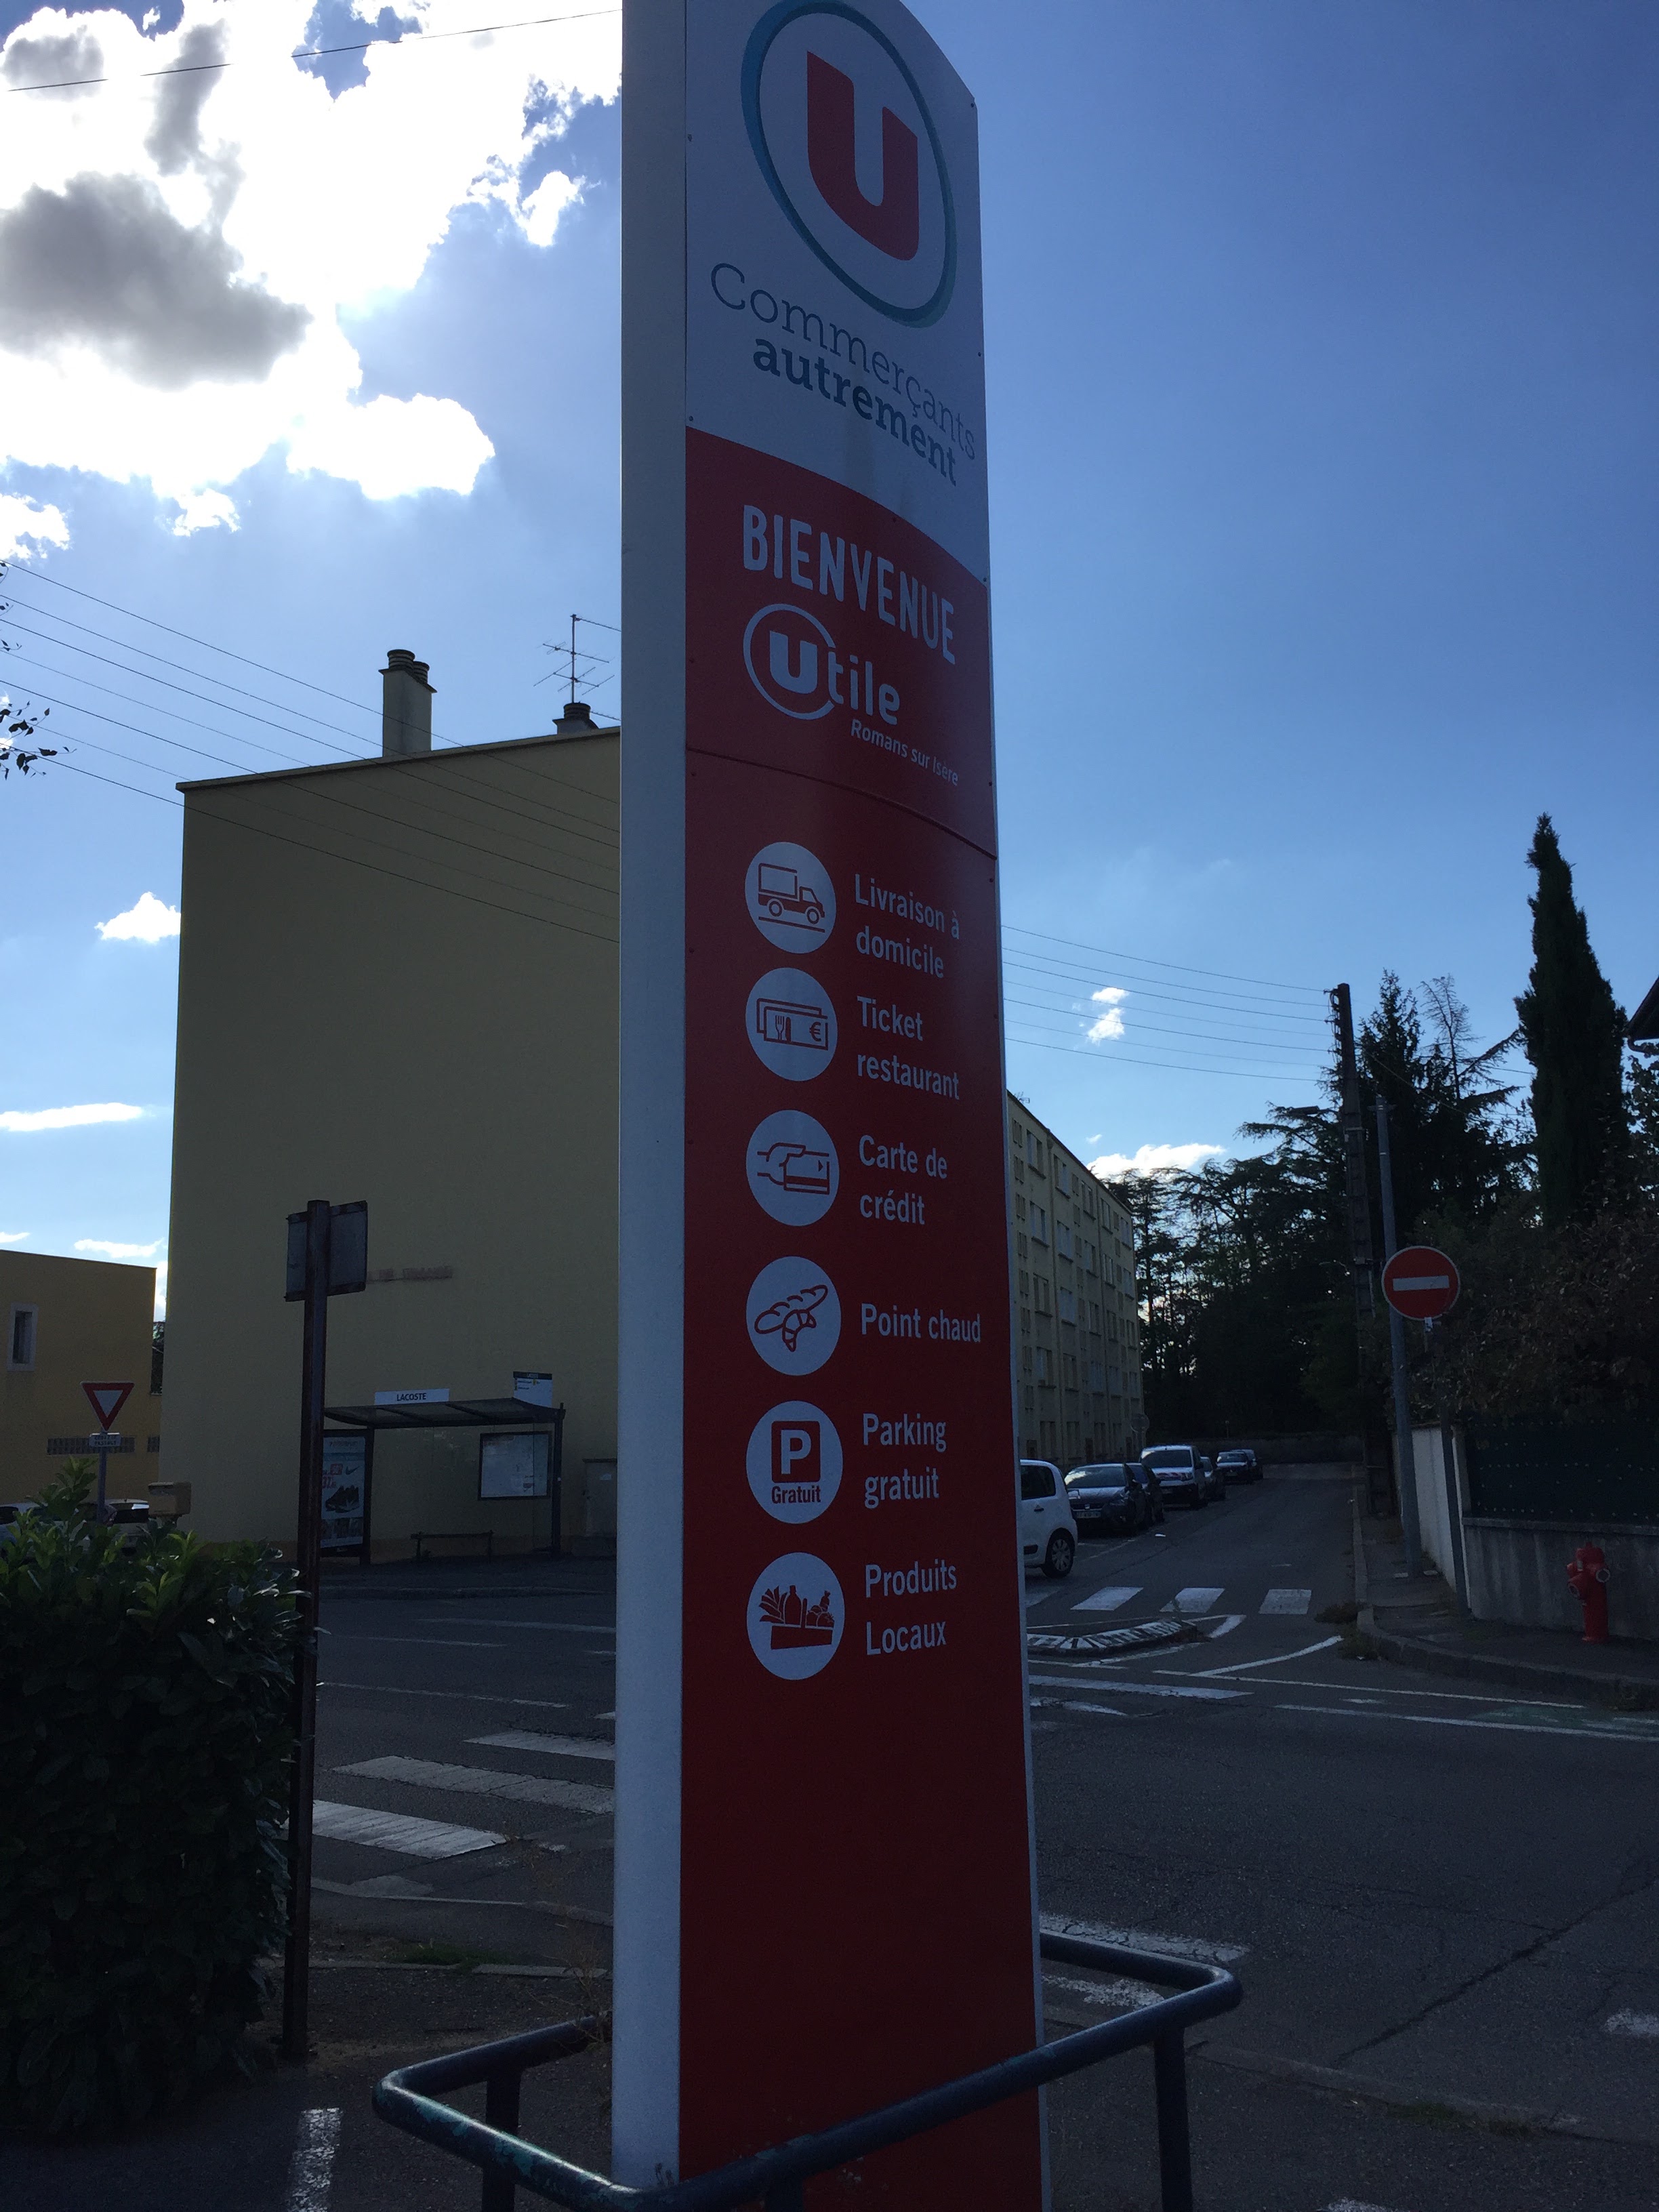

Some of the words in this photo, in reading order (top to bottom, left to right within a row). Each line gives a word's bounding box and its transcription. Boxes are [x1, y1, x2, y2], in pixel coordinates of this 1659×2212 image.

[806, 50, 918, 262] U
[710, 263, 975, 460] Commerçants
[753, 338, 956, 487] autrement
[743, 505, 956, 665] BIENVENUE
[851, 718, 908, 758] Romans
[911, 748, 930, 769] sur
[855, 874, 945, 933] Livraison
[951, 910, 960, 939] à
[856, 926, 943, 978] domicile
[857, 996, 923, 1041] Ticket
[857, 1054, 960, 1100] restaurant
[859, 1134, 918, 1173] Carte
[925, 1147, 947, 1179] de
[859, 1189, 925, 1225] crédit
[861, 1303, 921, 1338] Point
[928, 1309, 981, 1343] chaud
[396, 1393, 427, 1401] LACOSTE
[781, 1429, 812, 1475] P
[863, 1412, 947, 1453] Parking
[771, 1485, 821, 1504] Gratuit
[864, 1466, 939, 1509] gratuit
[865, 1559, 957, 1598] Produits
[866, 1621, 947, 1655] Locaux
